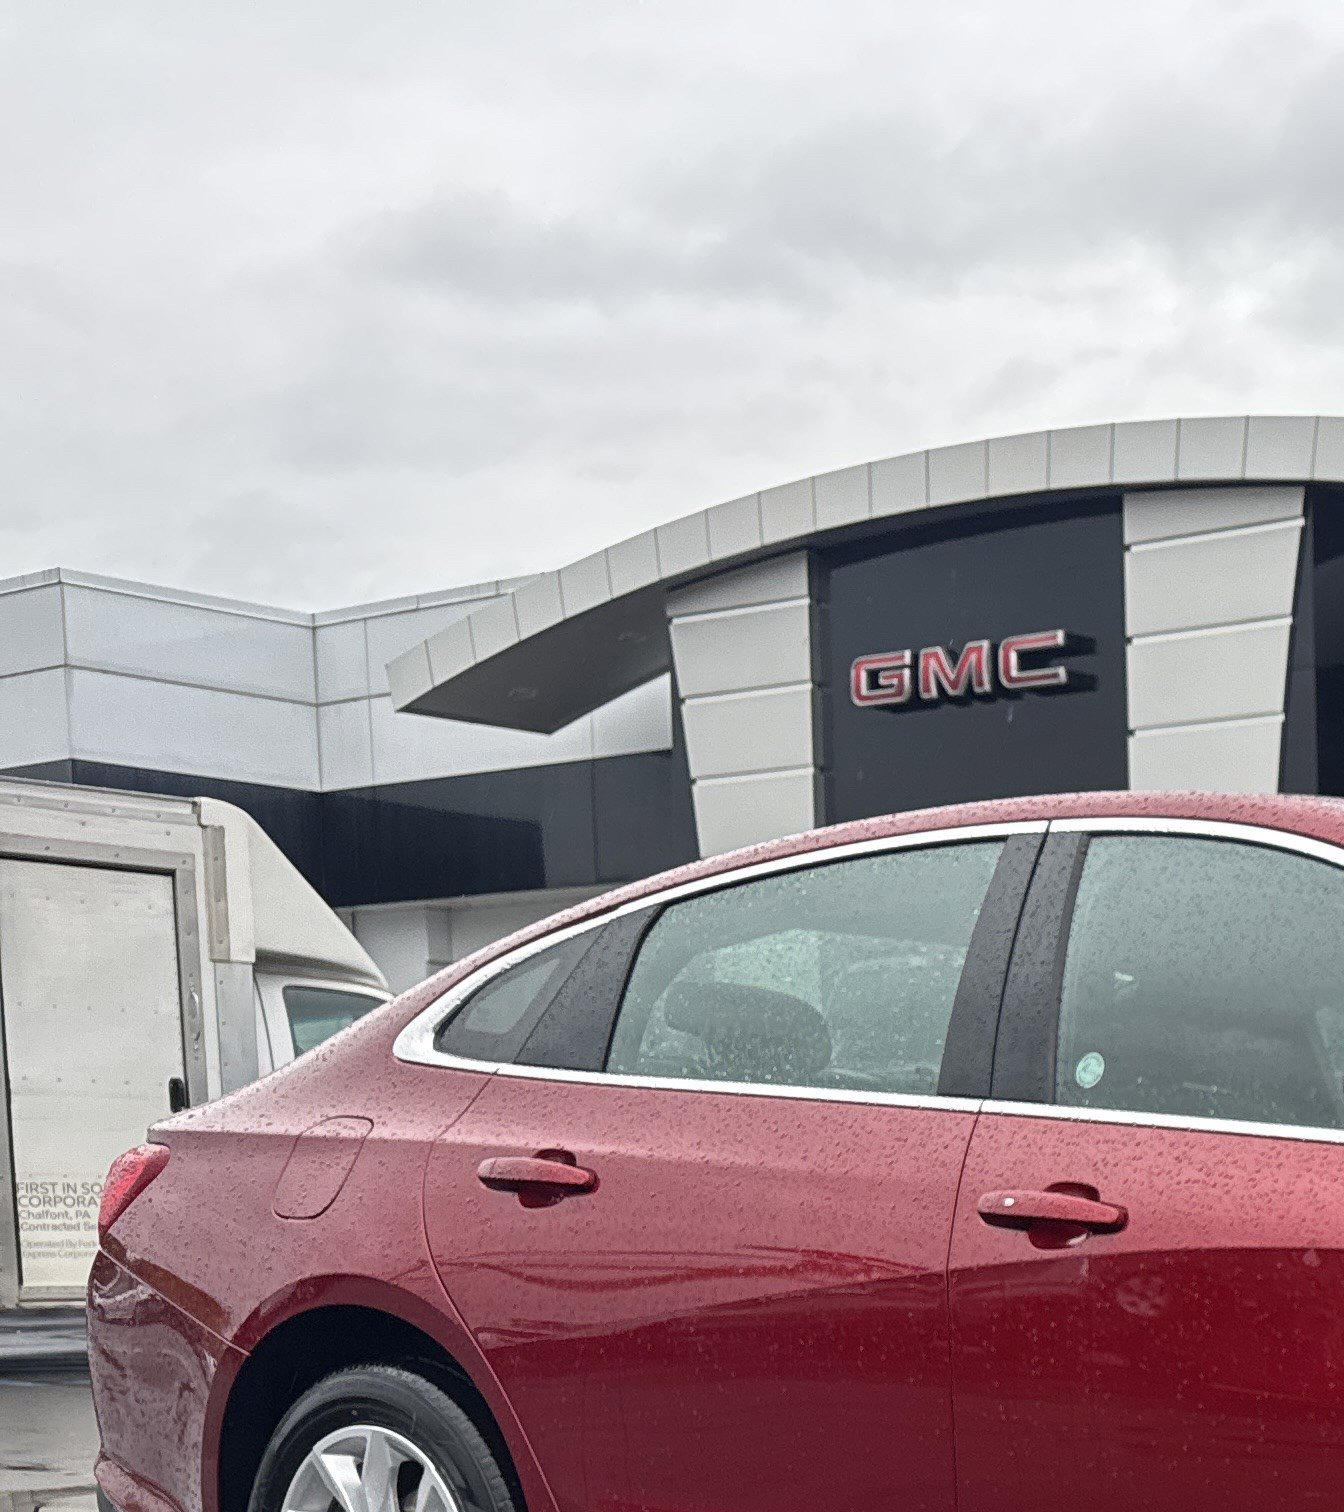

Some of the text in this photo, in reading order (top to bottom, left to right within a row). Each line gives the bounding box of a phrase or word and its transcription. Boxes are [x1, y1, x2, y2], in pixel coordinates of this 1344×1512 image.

[851, 629, 1067, 707] GMC
[16, 1182, 102, 1195] FIRST IN SO
[18, 1195, 98, 1208] CORPORA
[75, 1210, 91, 1219] PA
